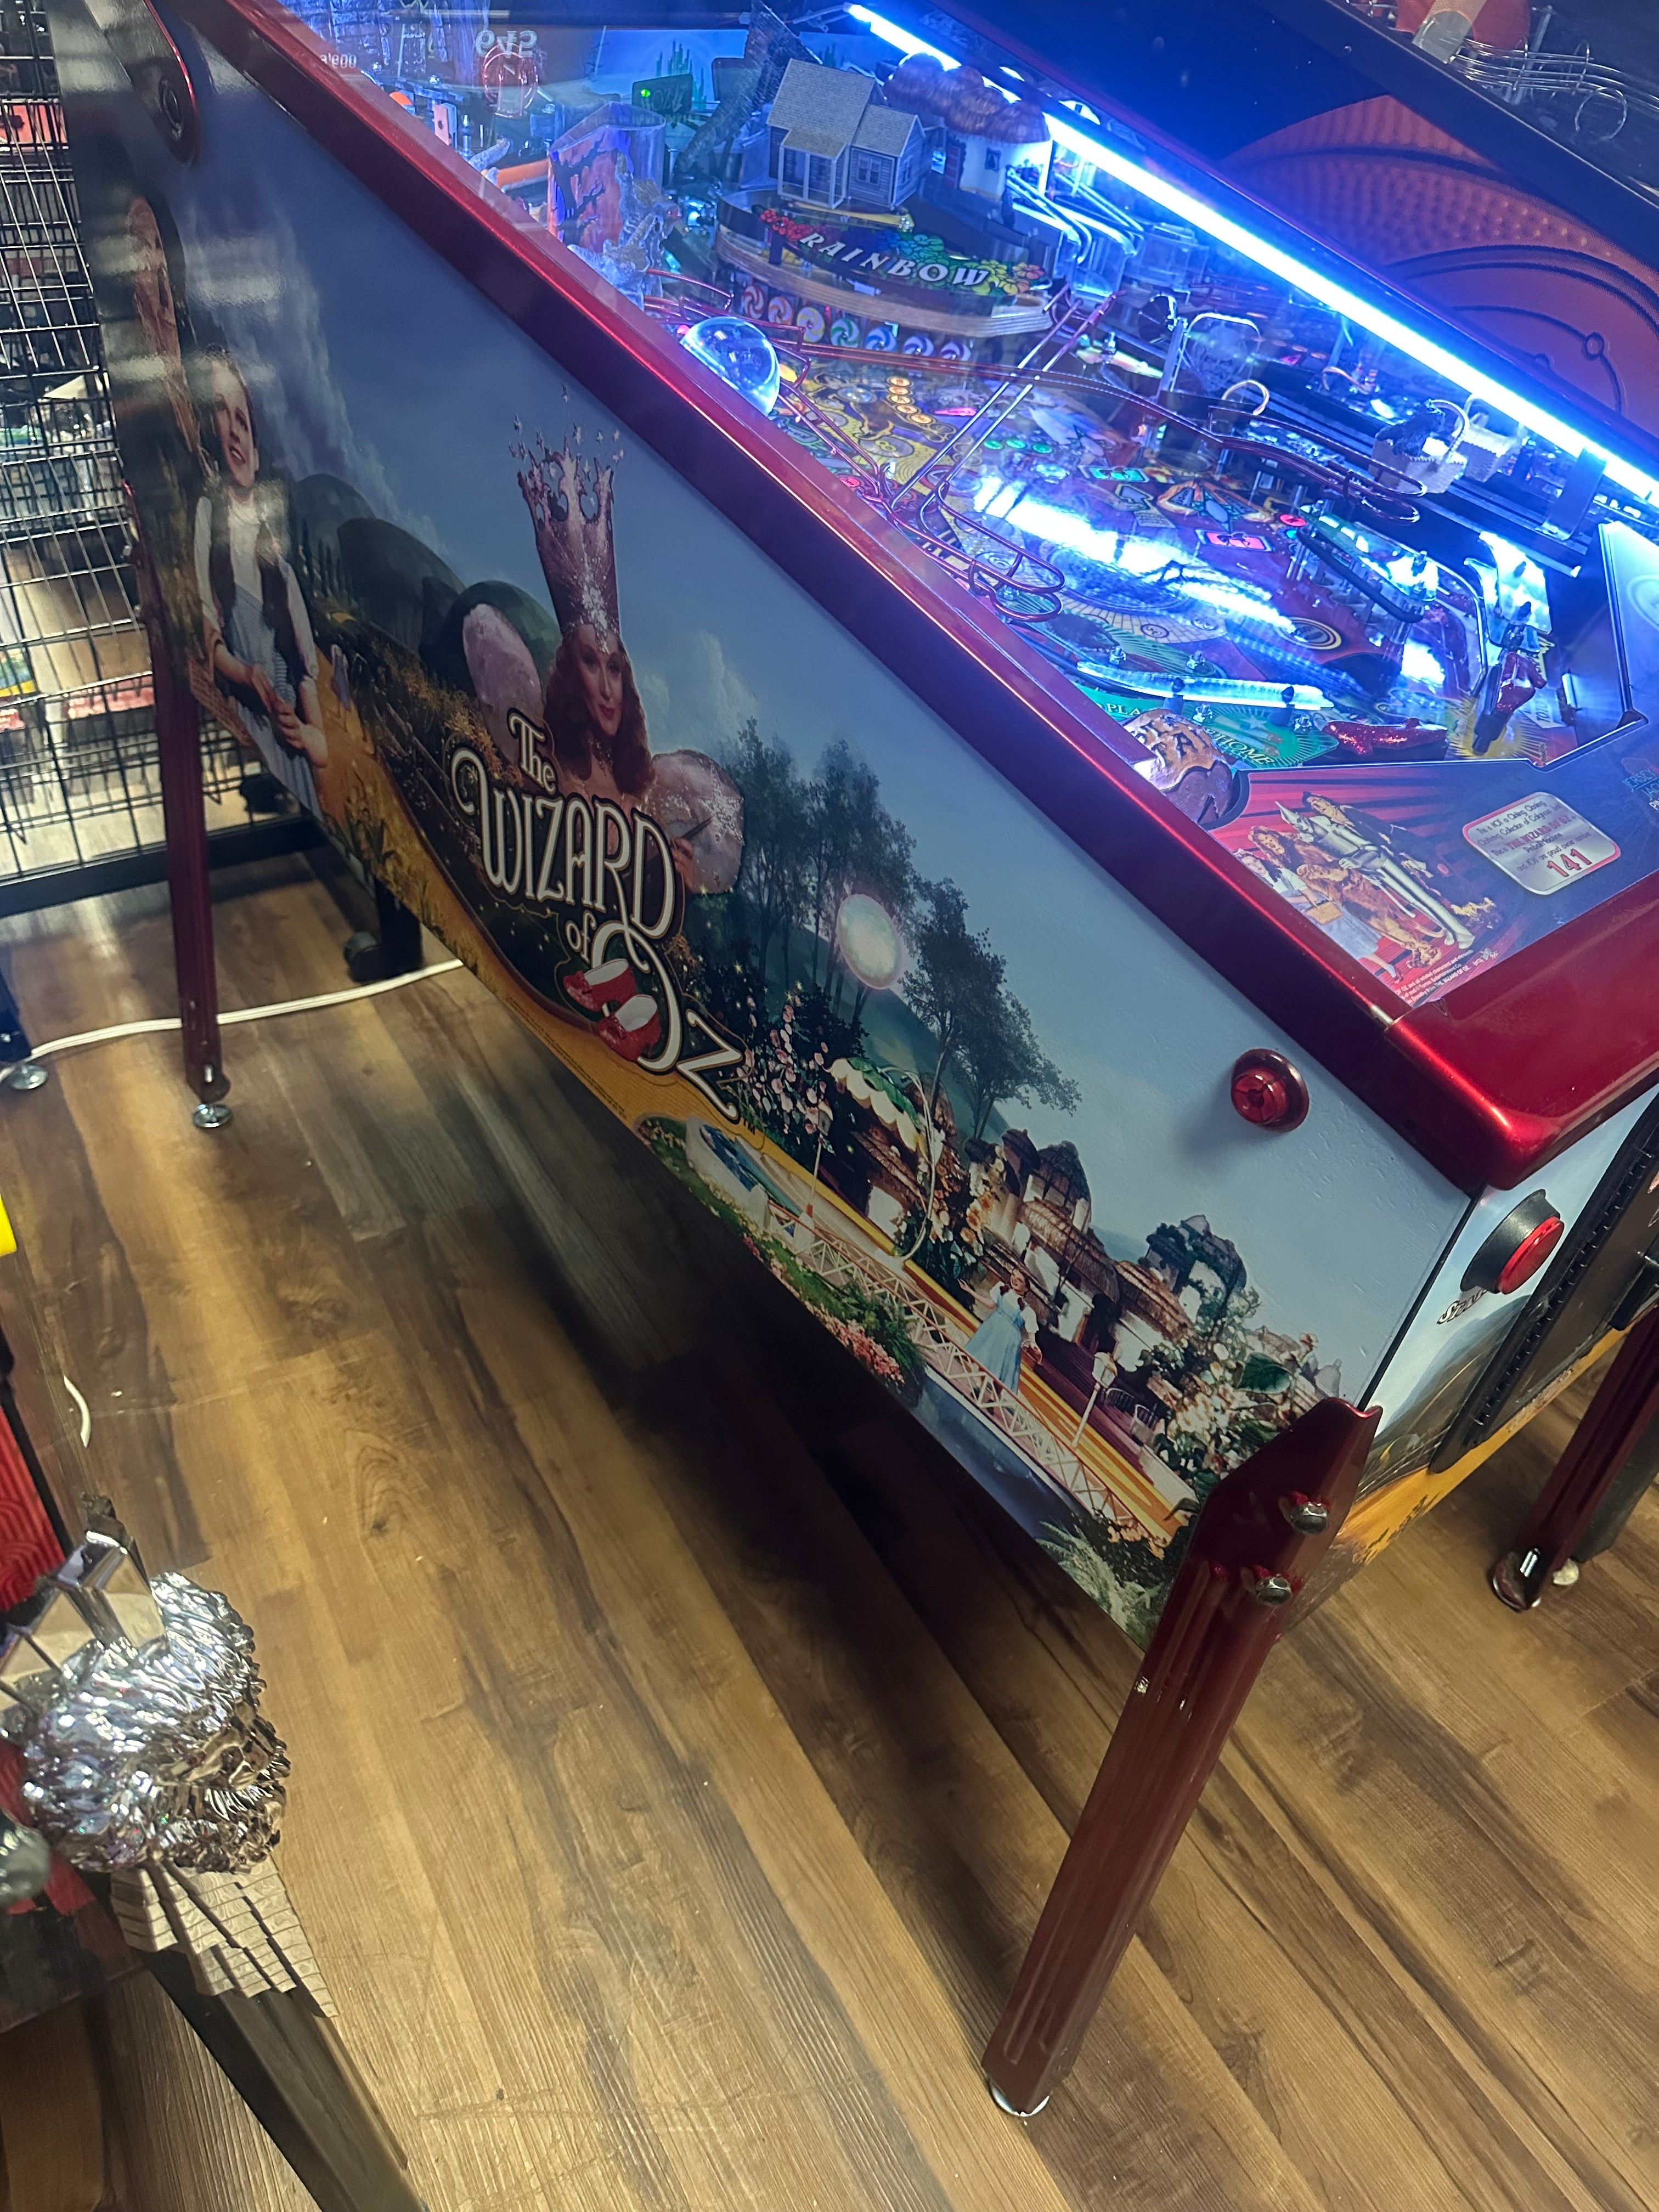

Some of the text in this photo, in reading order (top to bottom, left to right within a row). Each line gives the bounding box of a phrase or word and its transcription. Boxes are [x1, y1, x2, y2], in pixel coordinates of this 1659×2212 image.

[800, 232, 991, 287] RAINBOW
[1105, 703, 1141, 716] PLA
[509, 712, 557, 794] The
[1492, 819, 1504, 828] NOT
[451, 747, 676, 939] WIZARD
[1506, 836, 1525, 850] THE
[1522, 825, 1552, 844] WIZARD
[1547, 845, 1562, 858] proud
[1547, 848, 1593, 877] 141
[566, 911, 596, 963] of
[1442, 972, 1458, 984] WIZARD
